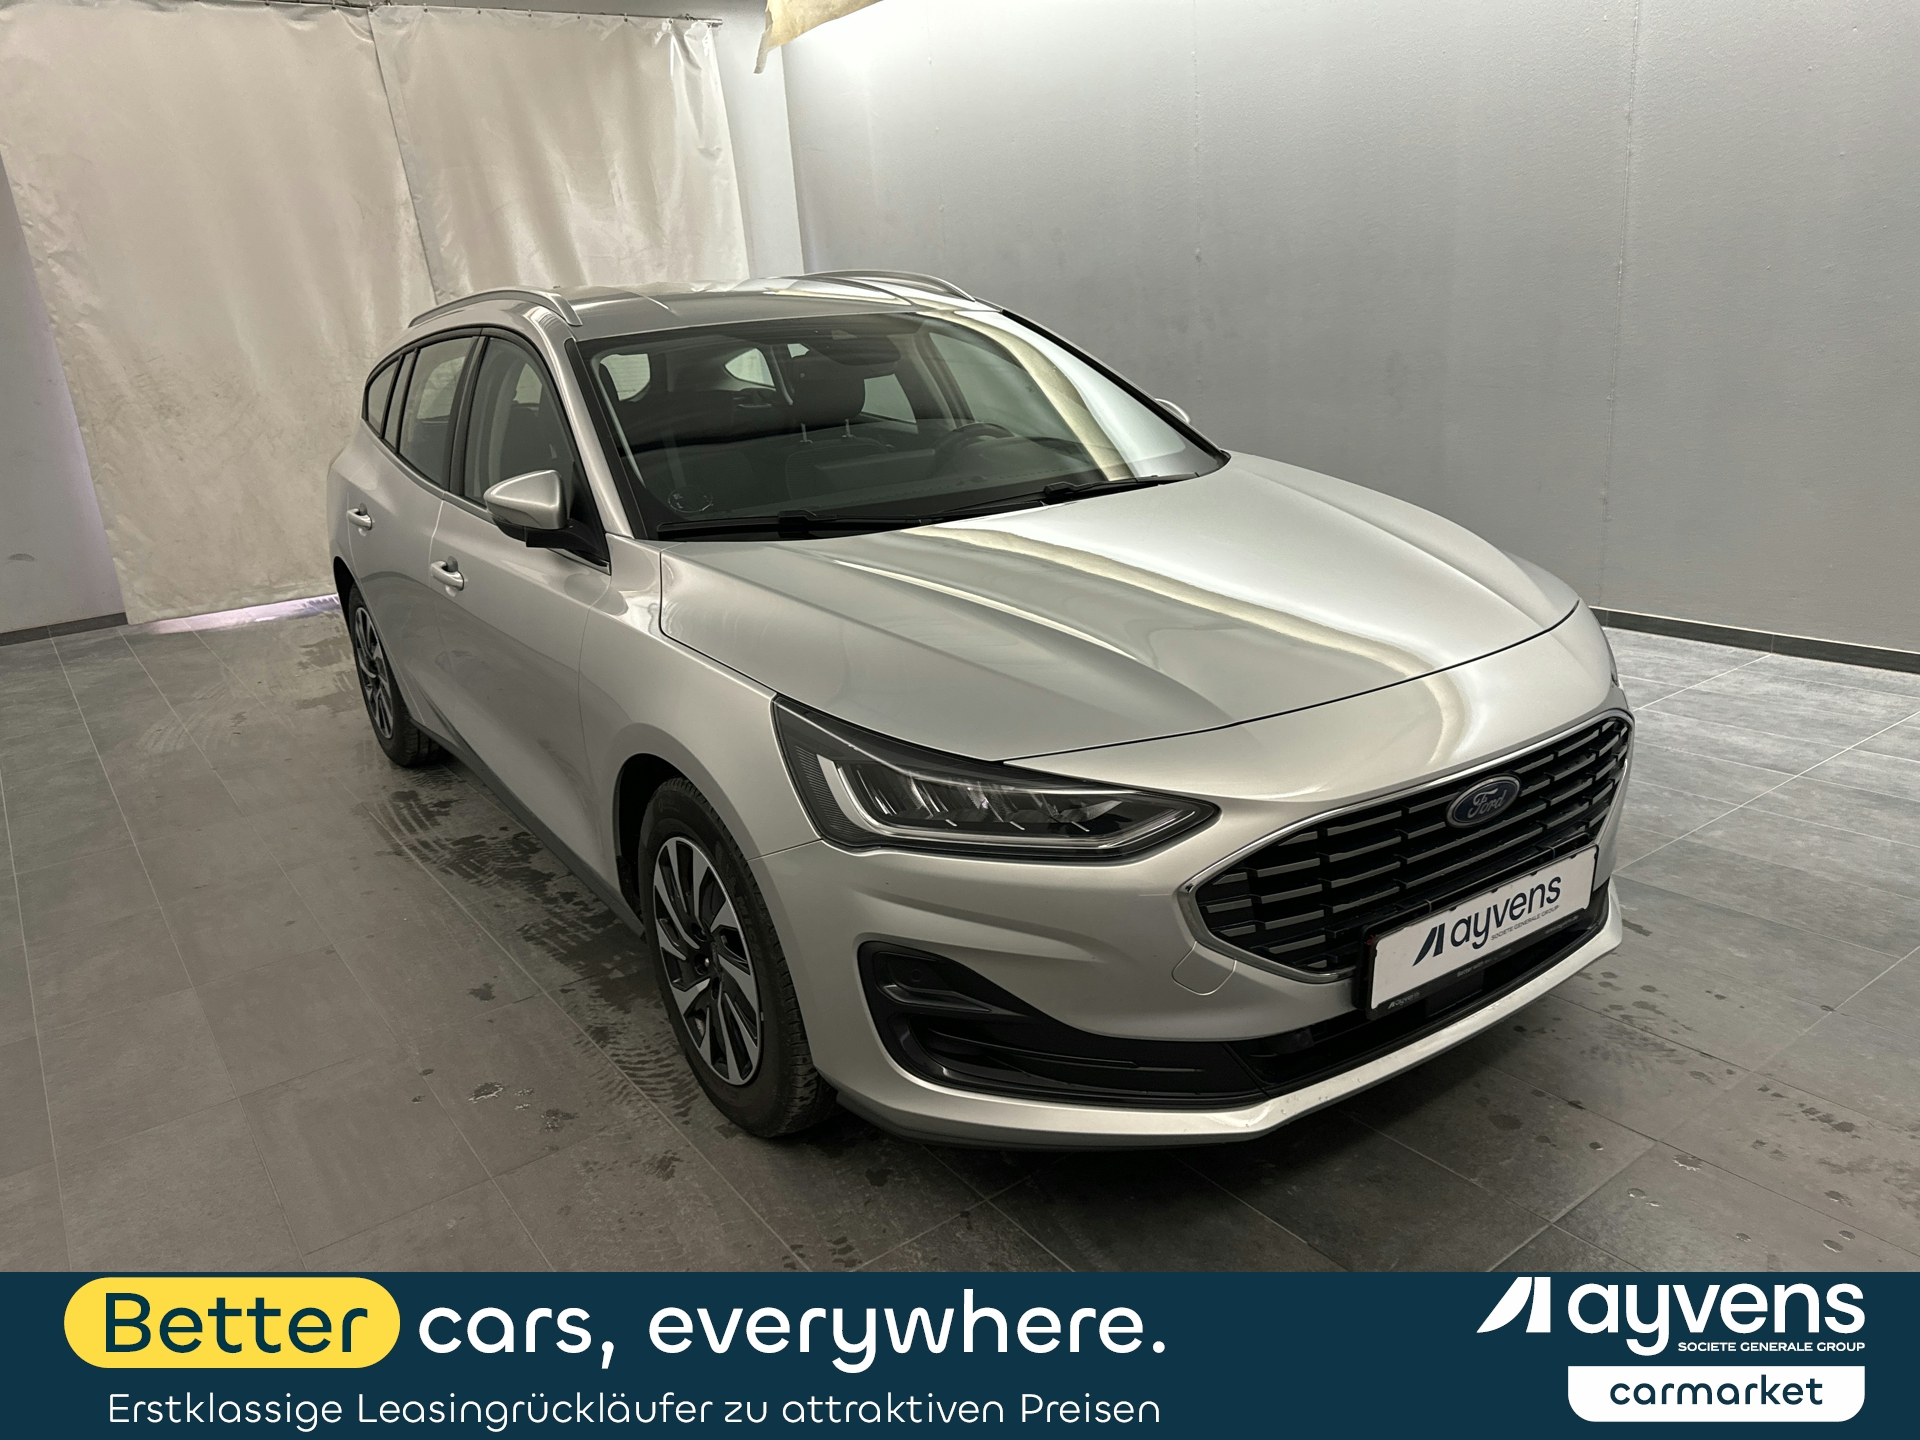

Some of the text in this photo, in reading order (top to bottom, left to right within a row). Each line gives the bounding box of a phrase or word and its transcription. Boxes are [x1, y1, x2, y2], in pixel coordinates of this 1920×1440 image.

[1467, 788, 1508, 819] Ford
[1450, 876, 1562, 950] ayvens
[1491, 925, 1514, 941] SOCIETE
[1513, 912, 1541, 930] GENERALE
[1541, 904, 1560, 917] GROUP
